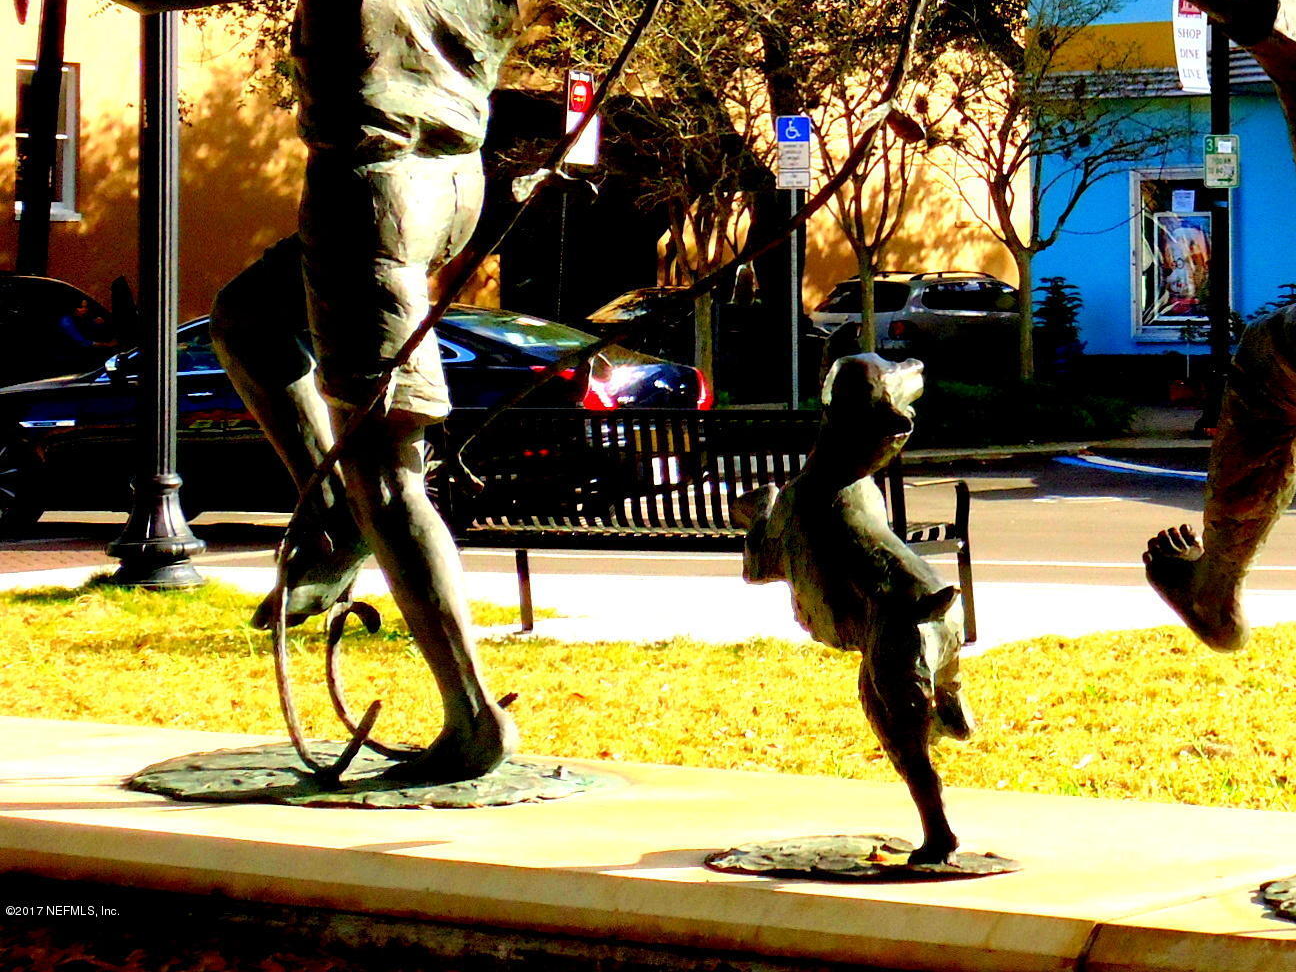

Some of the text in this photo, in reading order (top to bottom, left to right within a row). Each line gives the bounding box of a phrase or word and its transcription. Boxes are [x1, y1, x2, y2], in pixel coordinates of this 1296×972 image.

[1177, 28, 1202, 40] SHOP
[1179, 48, 1201, 60] DINE
[1181, 68, 1202, 80] LIVE
